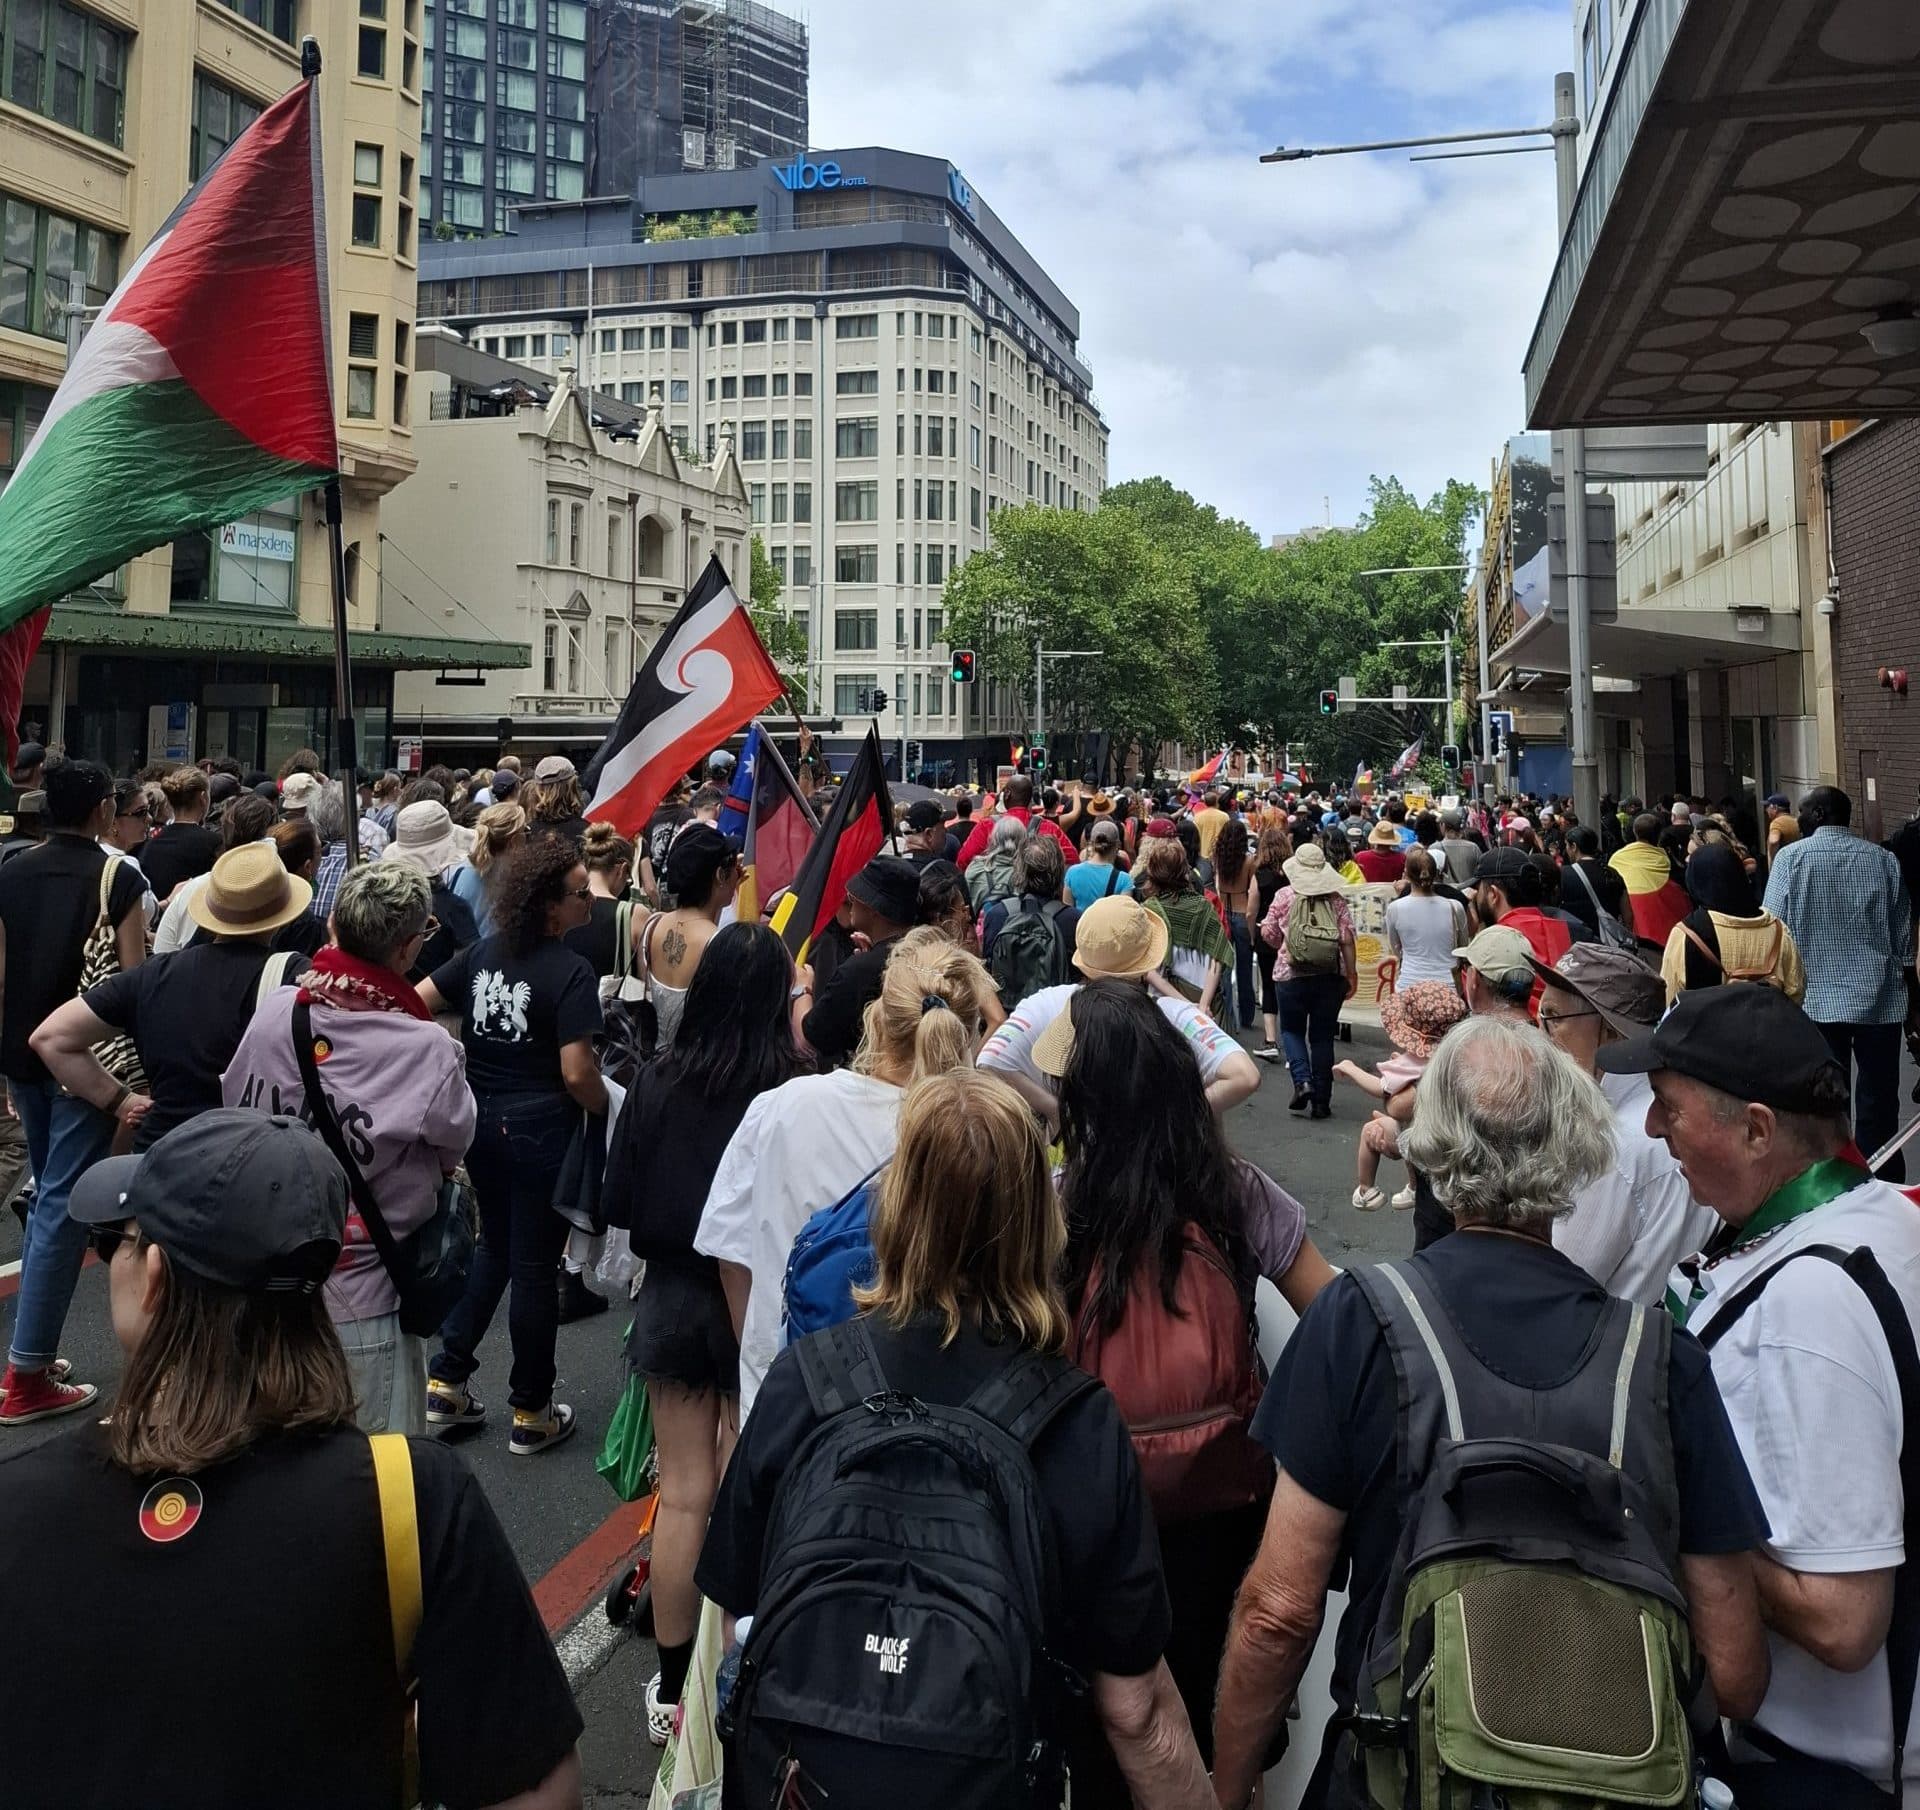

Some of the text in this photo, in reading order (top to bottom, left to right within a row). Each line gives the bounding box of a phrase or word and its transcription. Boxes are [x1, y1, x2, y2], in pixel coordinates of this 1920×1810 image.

[771, 152, 869, 190] vibe HOTEL
[238, 531, 293, 554] marsdens
[864, 1633, 901, 1656] BLACK
[879, 1653, 908, 1674] WOLF
